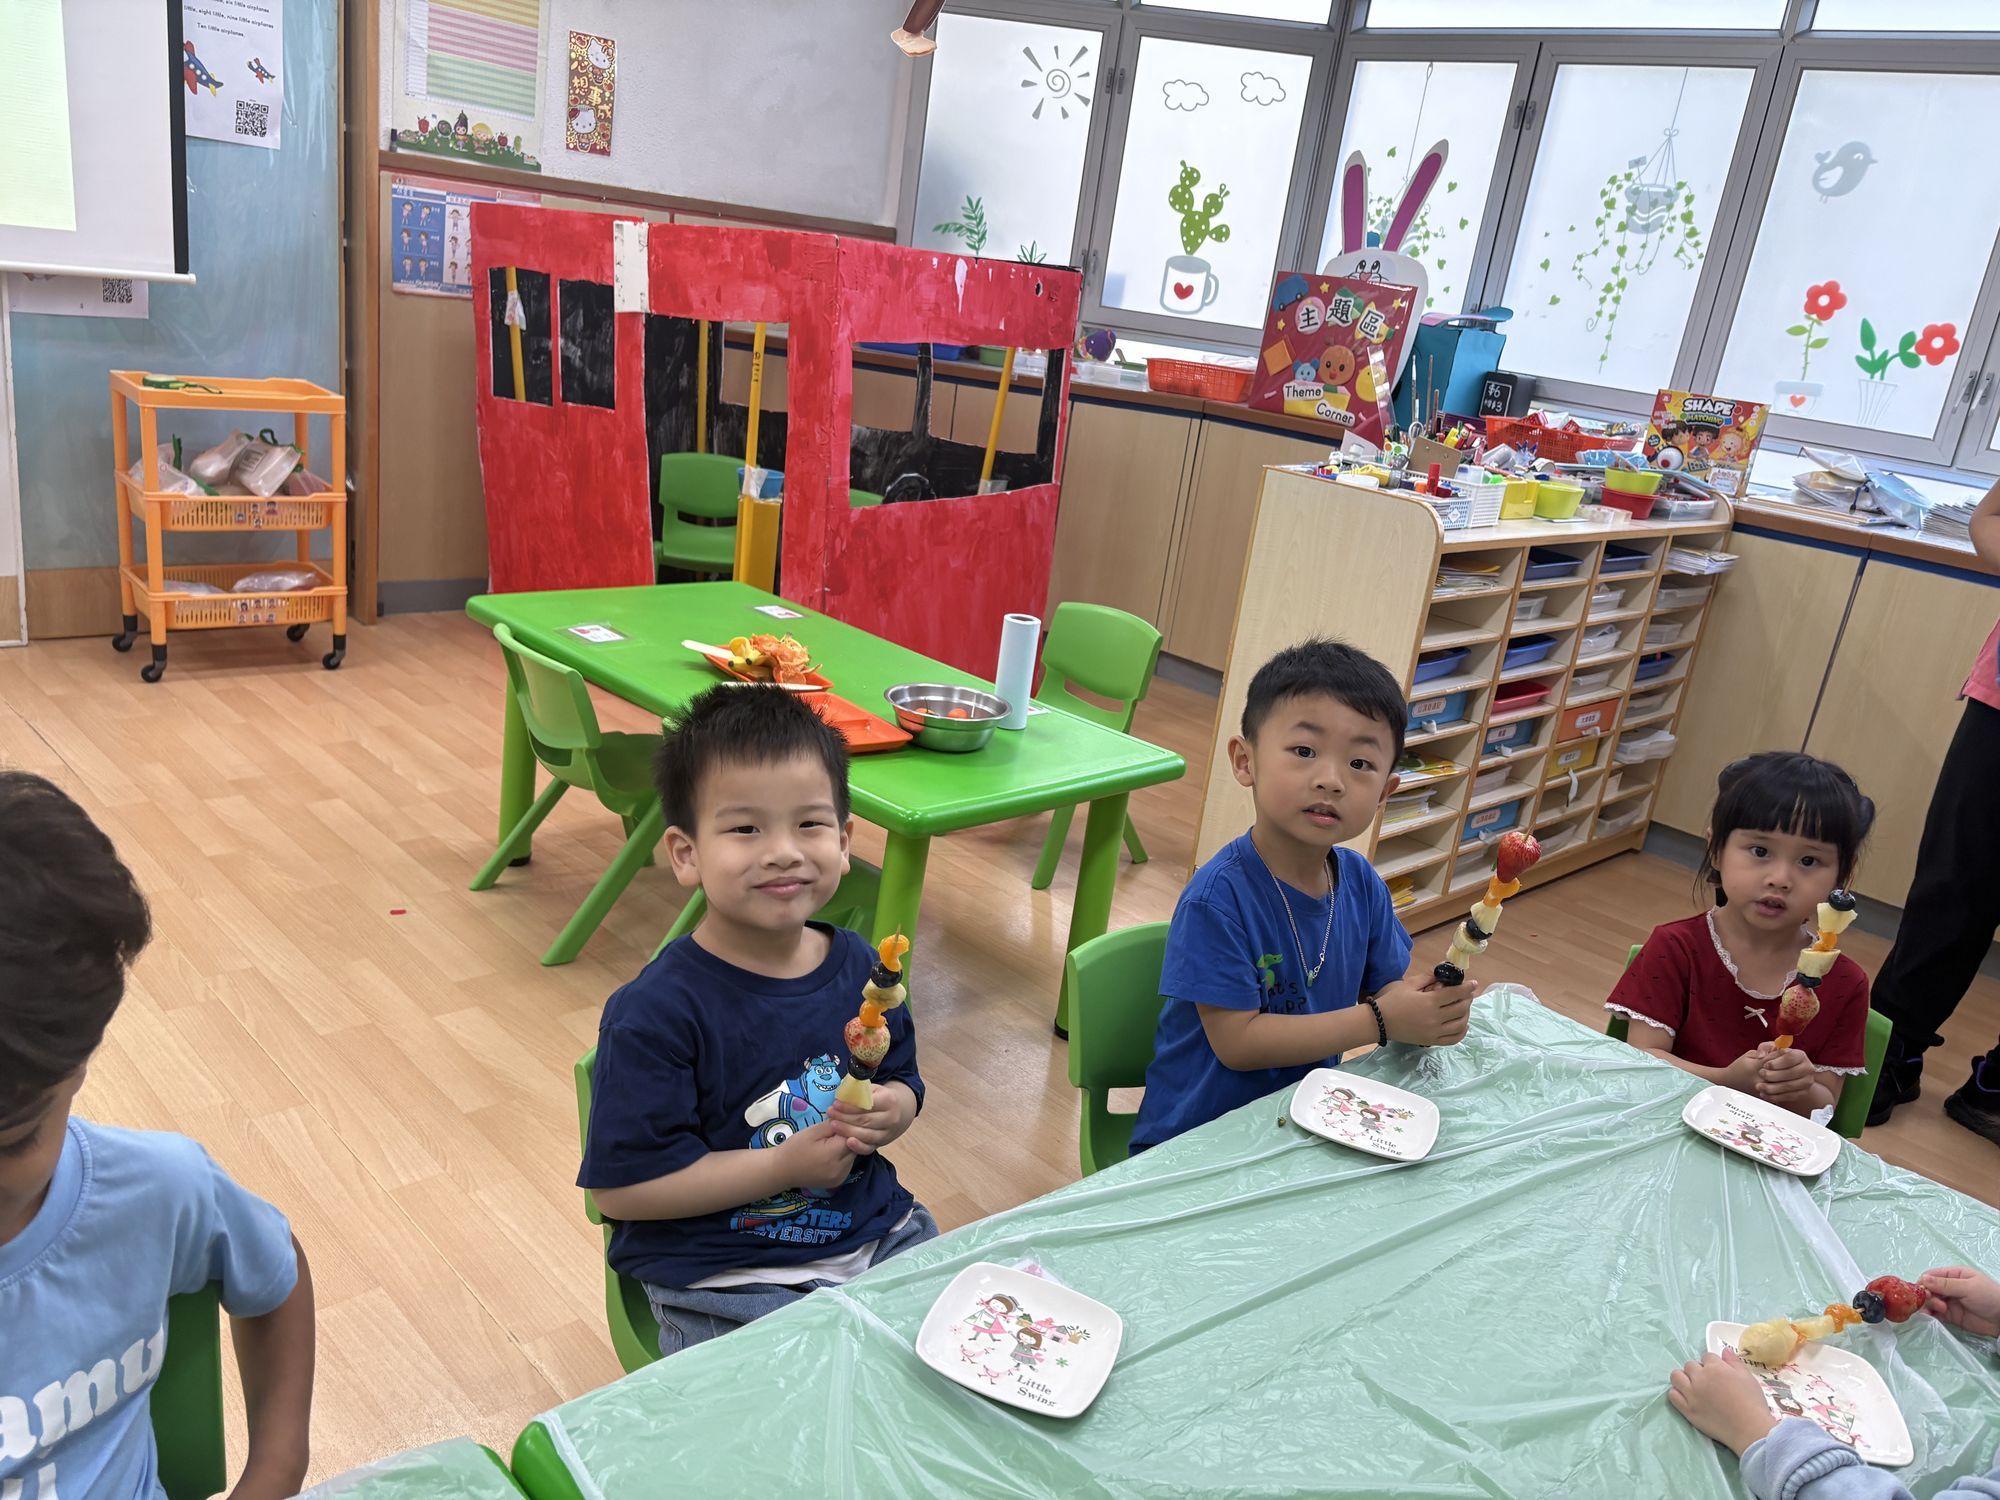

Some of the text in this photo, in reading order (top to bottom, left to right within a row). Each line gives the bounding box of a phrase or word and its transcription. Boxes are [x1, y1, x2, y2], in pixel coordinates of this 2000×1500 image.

[246, 4, 270, 13] airplanes
[198, 8, 212, 16] eight
[251, 20, 274, 29] airplanes
[207, 24, 220, 32] little
[1299, 298, 1385, 339] 主題區
[1285, 385, 1322, 398] Theme
[1316, 402, 1354, 424] Corner
[1683, 399, 1734, 416] SHAPE
[1369, 1135, 1397, 1149] Little
[1017, 1374, 1052, 1395] Little
[1017, 1386, 1057, 1408] Swing
